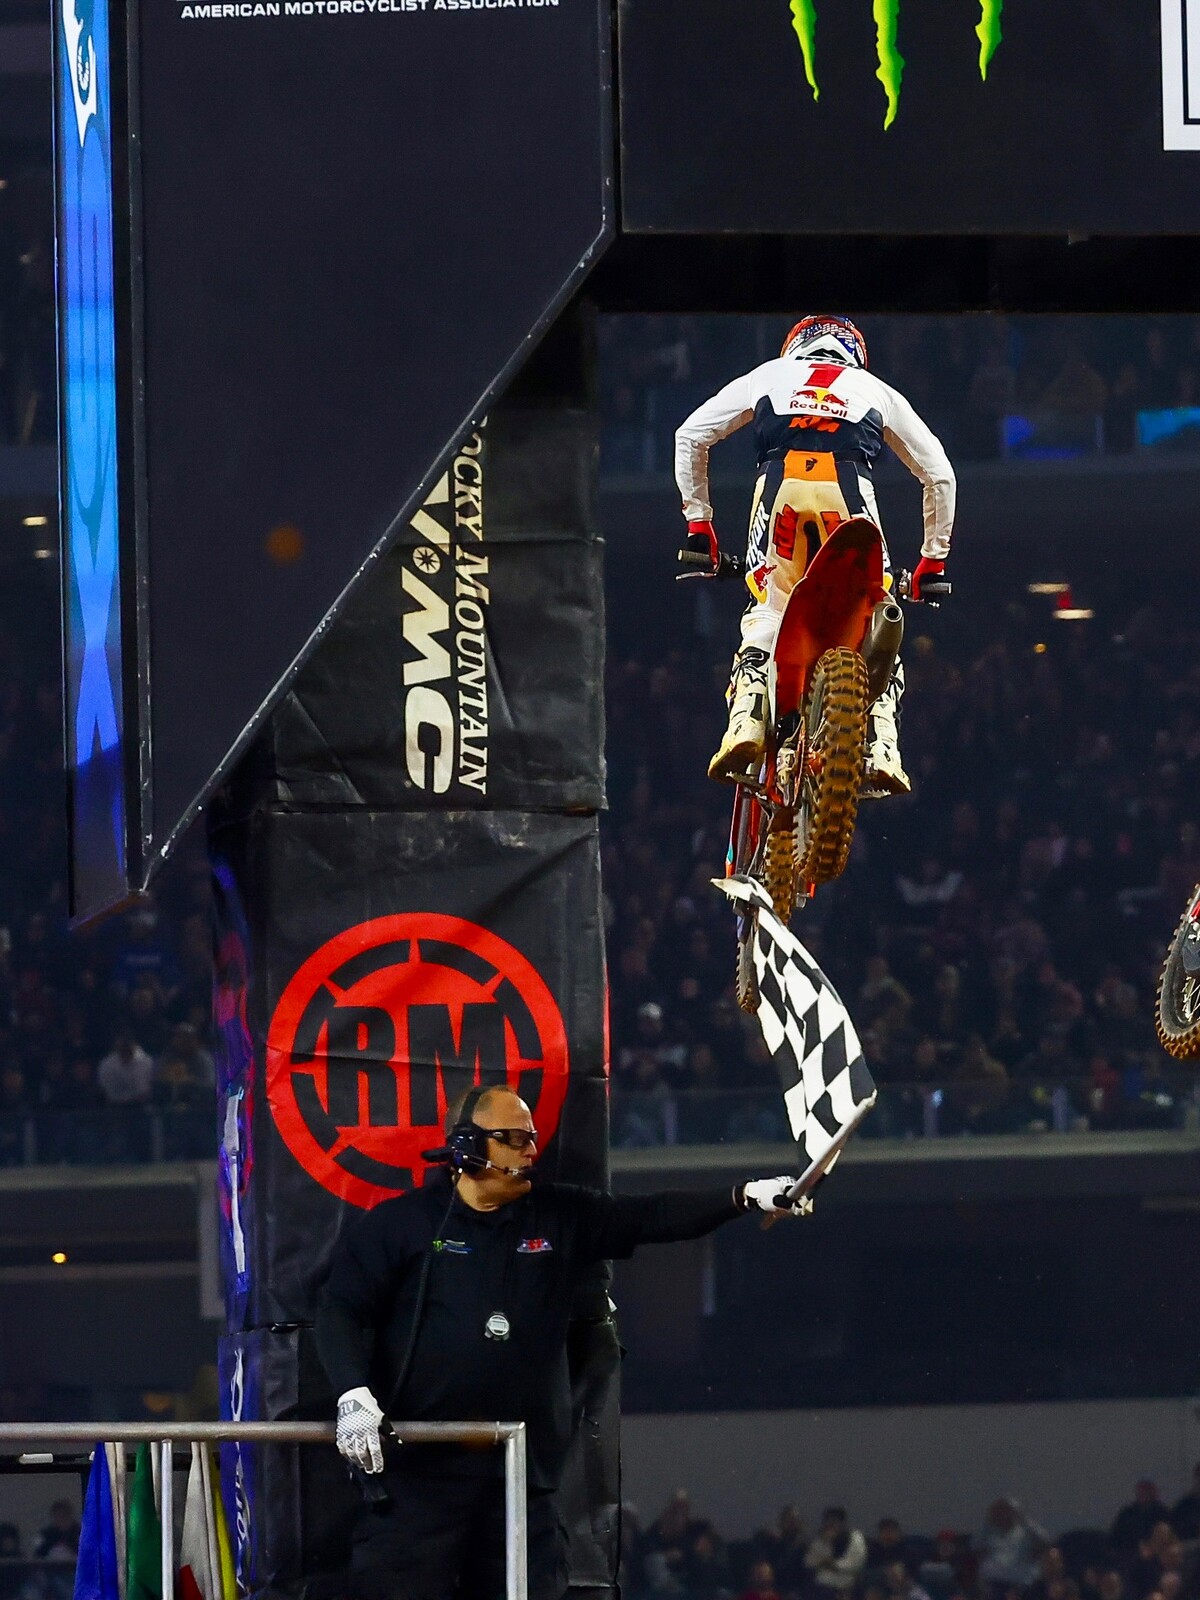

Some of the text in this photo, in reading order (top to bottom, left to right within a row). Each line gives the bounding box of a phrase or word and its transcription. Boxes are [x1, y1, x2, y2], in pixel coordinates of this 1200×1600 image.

[180, 4, 281, 19] AMERICAN
[284, 0, 430, 15] MOTORCYCLIST
[803, 363, 847, 389] 1
[789, 400, 849, 418] Red Bull
[454, 542, 491, 796] MOUNTAIN
[325, 1002, 525, 1128] RM
